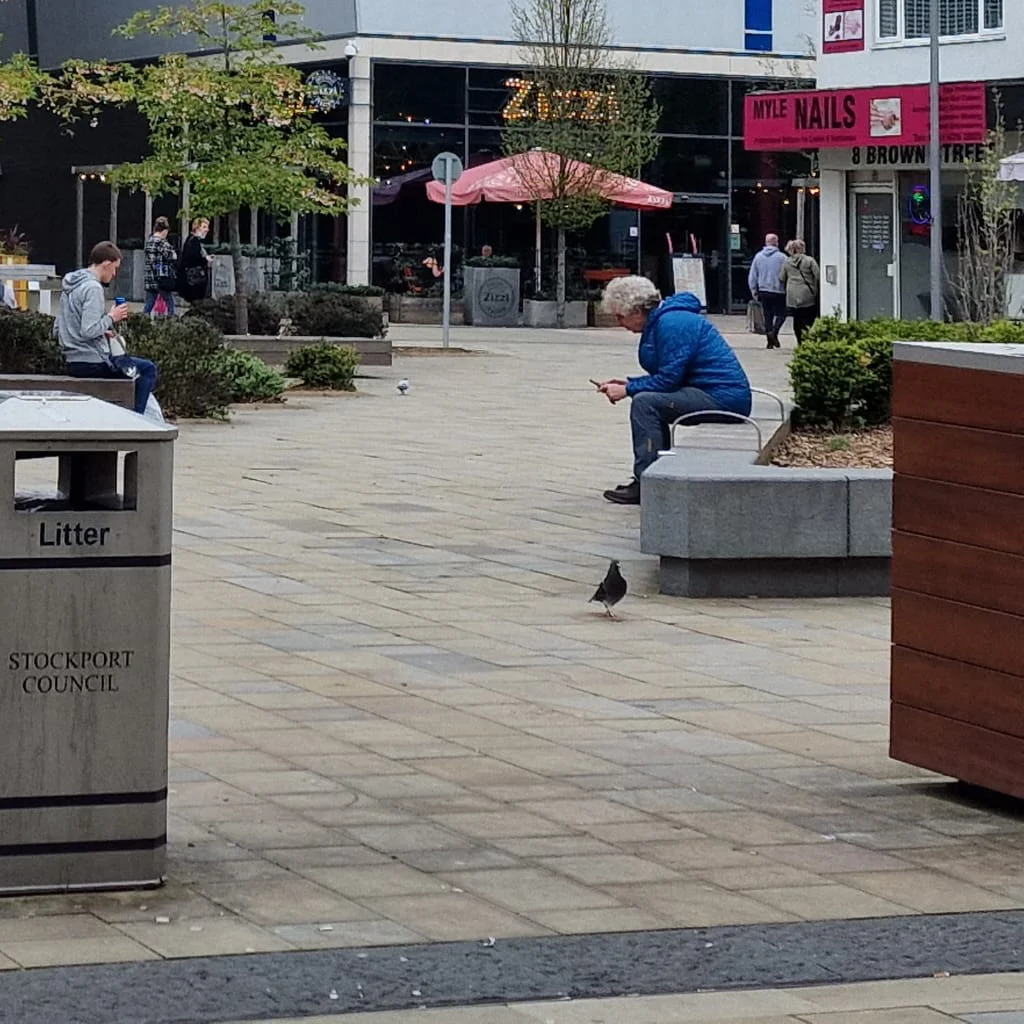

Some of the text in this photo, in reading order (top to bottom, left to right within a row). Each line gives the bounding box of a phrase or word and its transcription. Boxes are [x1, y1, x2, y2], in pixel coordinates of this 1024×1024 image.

[753, 95, 856, 129] MYLE NAILS
[851, 142, 995, 164] 8 BROWN TREE
[39, 521, 110, 547] Litter
[8, 651, 135, 671] STOCKPORT
[22, 674, 120, 694] COUNCIL
